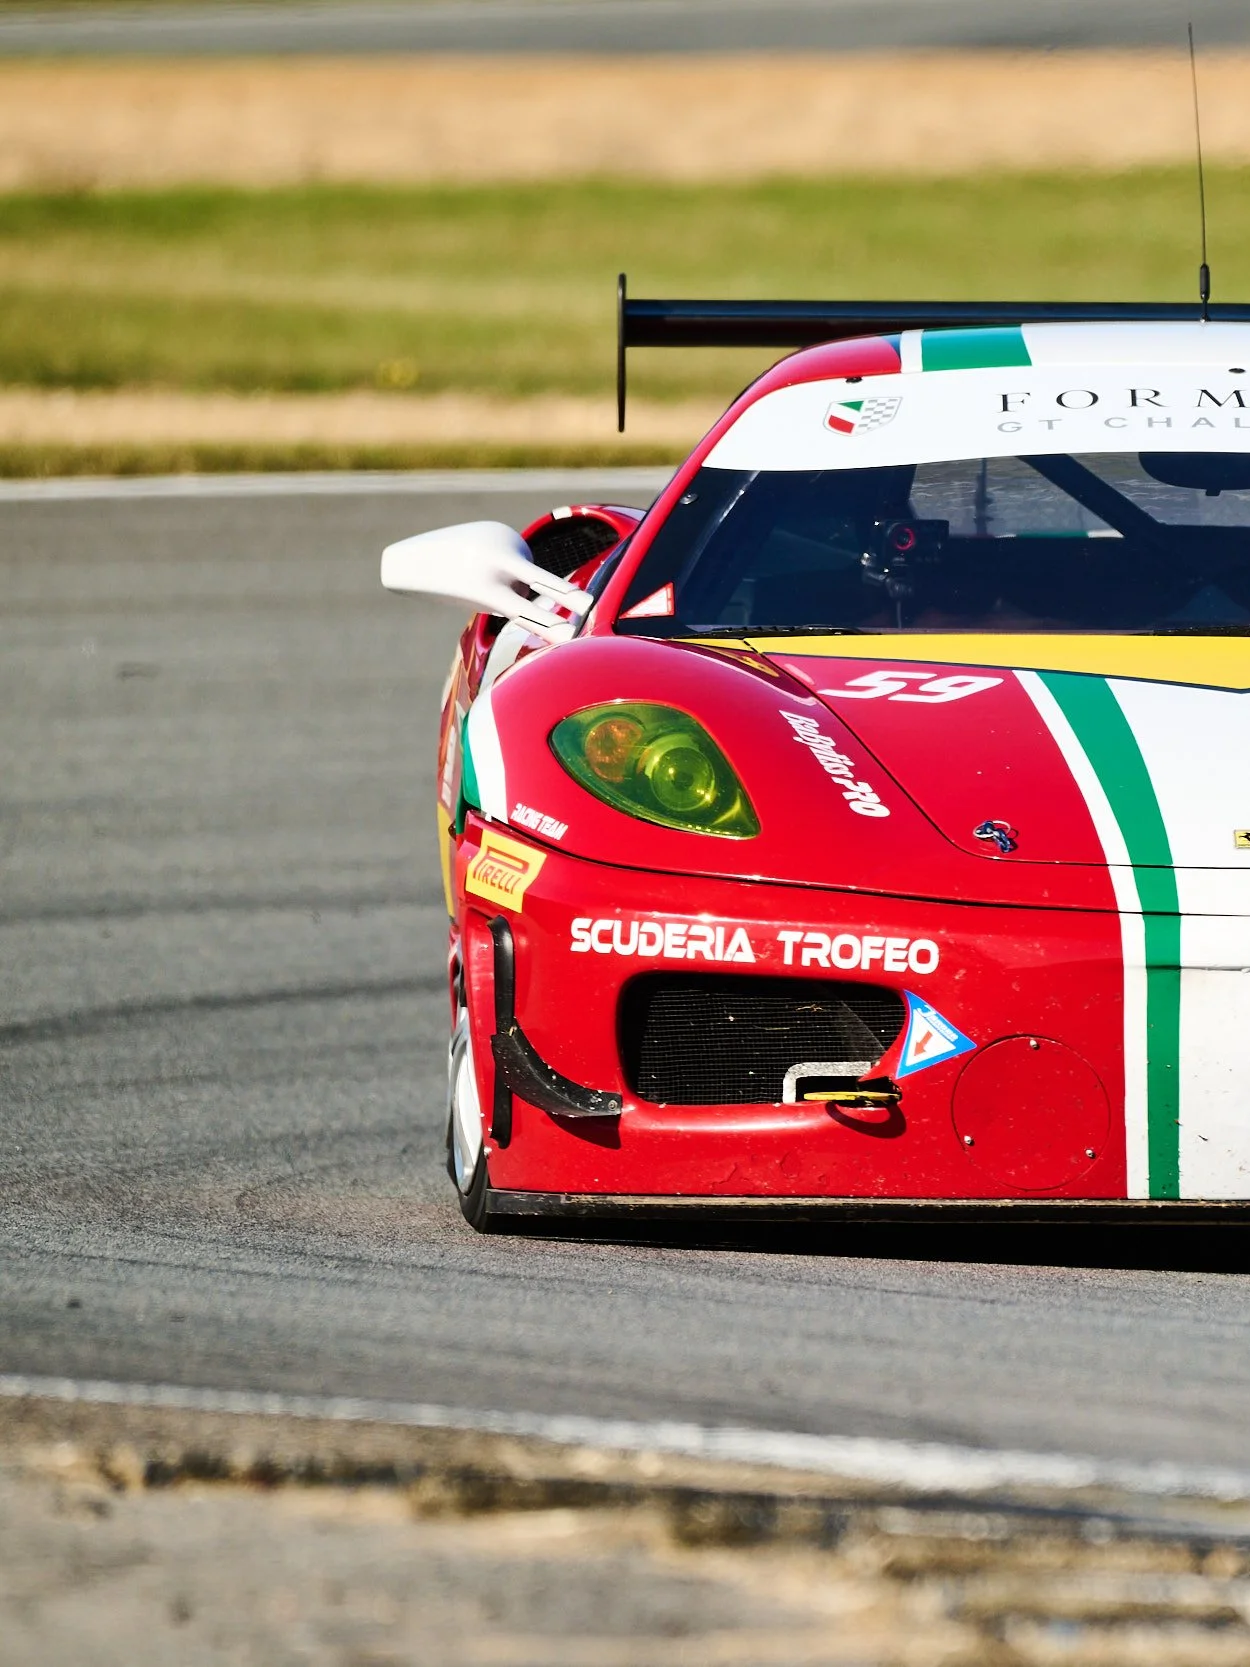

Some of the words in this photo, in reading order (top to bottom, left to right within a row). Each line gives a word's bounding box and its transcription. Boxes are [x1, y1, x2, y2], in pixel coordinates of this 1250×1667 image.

[996, 419, 1063, 433] GT
[816, 669, 1004, 703] 59
[510, 802, 544, 830] RACING
[537, 815, 569, 841] TEAM
[472, 845, 530, 895] PIRELLI
[570, 917, 757, 964] SCUDERIA
[776, 930, 940, 975] TROFEO
